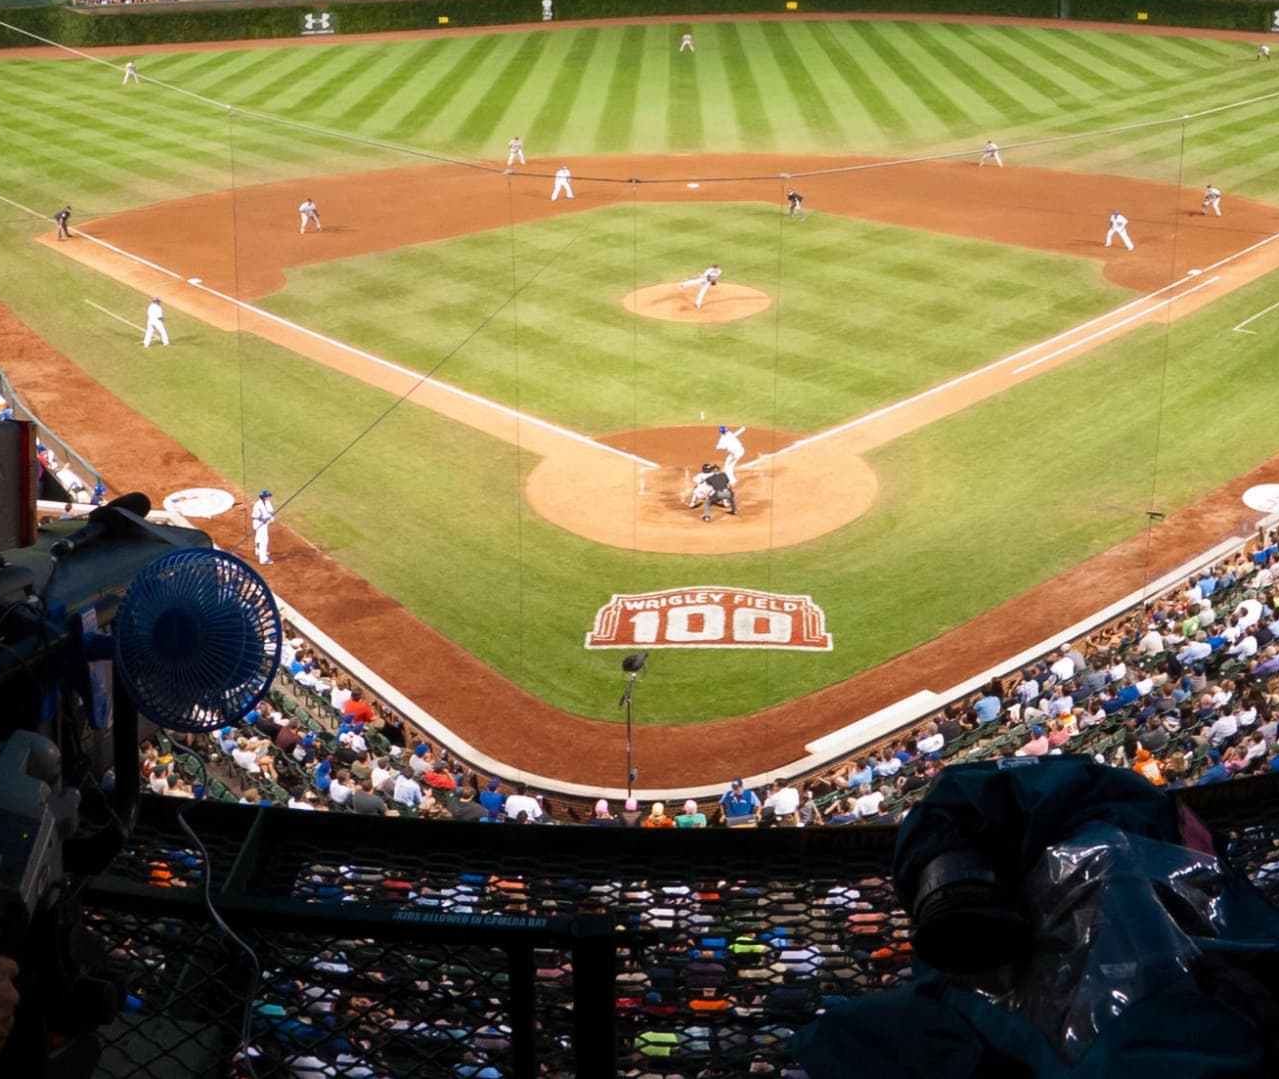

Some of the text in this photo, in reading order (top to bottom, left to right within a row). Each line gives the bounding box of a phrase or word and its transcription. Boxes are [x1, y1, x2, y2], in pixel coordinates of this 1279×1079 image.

[625, 593, 798, 612] WRIGLEY FIELD
[629, 605, 793, 643] 100
